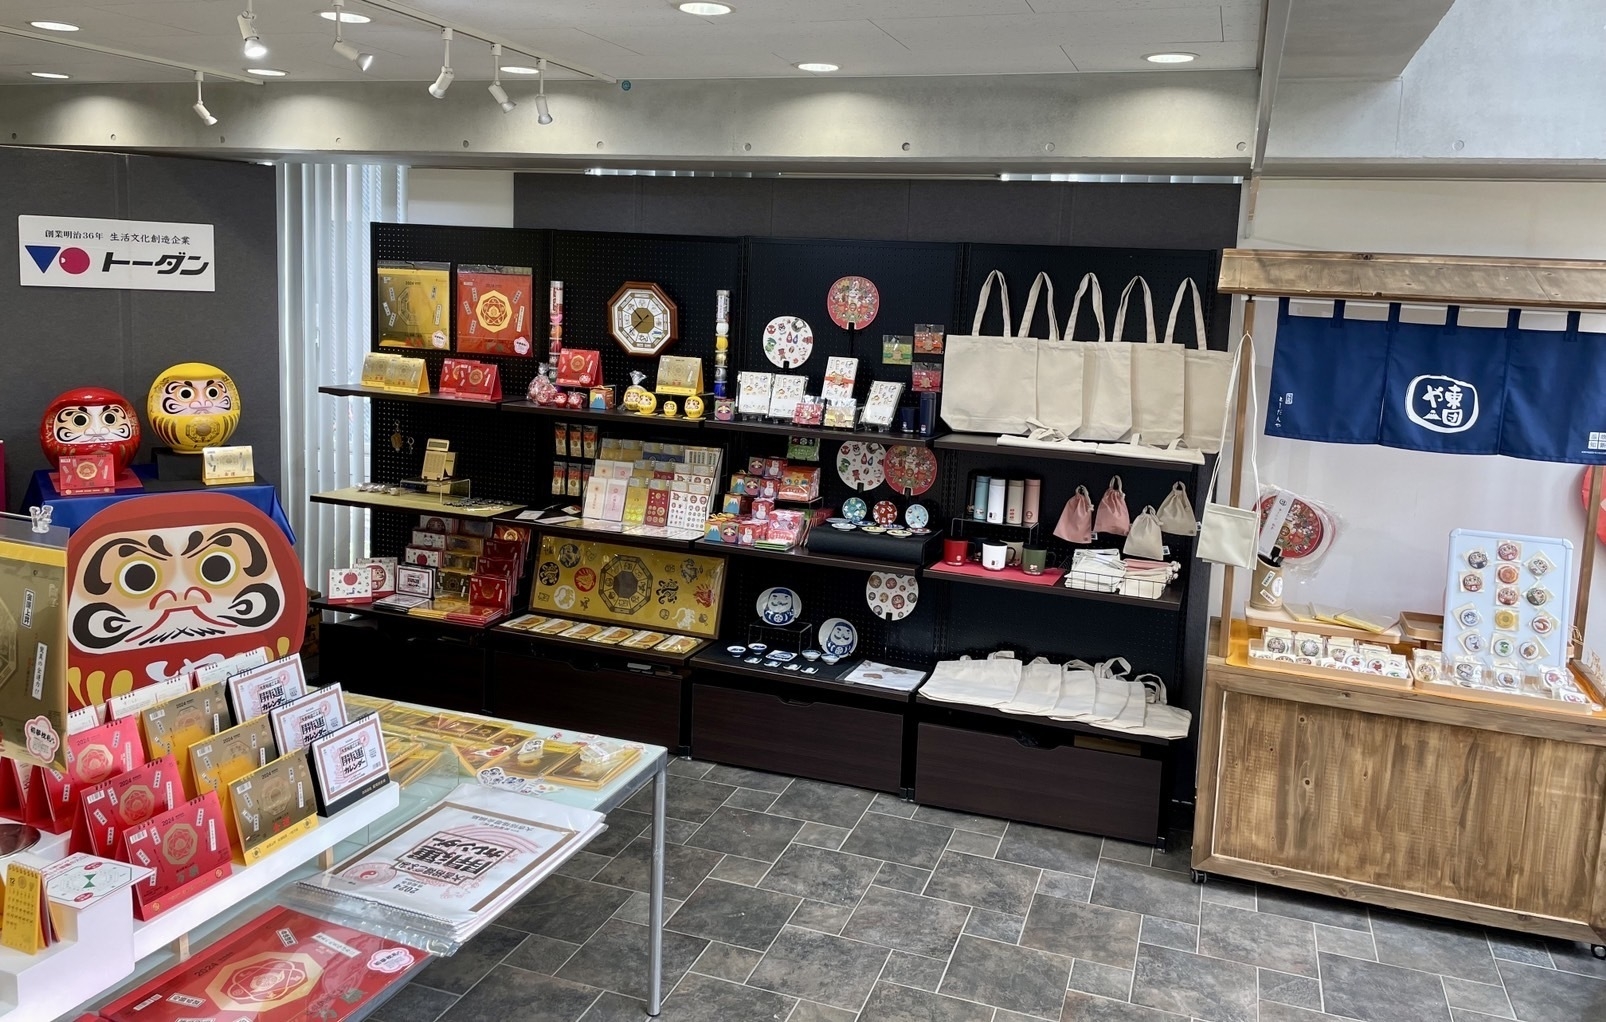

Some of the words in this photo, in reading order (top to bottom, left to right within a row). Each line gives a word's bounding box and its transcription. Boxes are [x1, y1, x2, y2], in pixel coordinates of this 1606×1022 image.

[45, 229, 104, 240] 創業明治36年
[109, 233, 191, 246] 生活文化創造企業
[102, 252, 210, 276] トーダン
[259, 686, 284, 702] 開運
[262, 697, 286, 711] カレンダー
[301, 716, 325, 736] 開運
[304, 729, 327, 744] カレンダー
[341, 747, 364, 766] 開運
[344, 759, 366, 774] カレンダー
[430, 837, 507, 860] カレンダー
[407, 846, 493, 875] 開運
[392, 883, 420, 894] 2024
[193, 962, 219, 977] 2024
